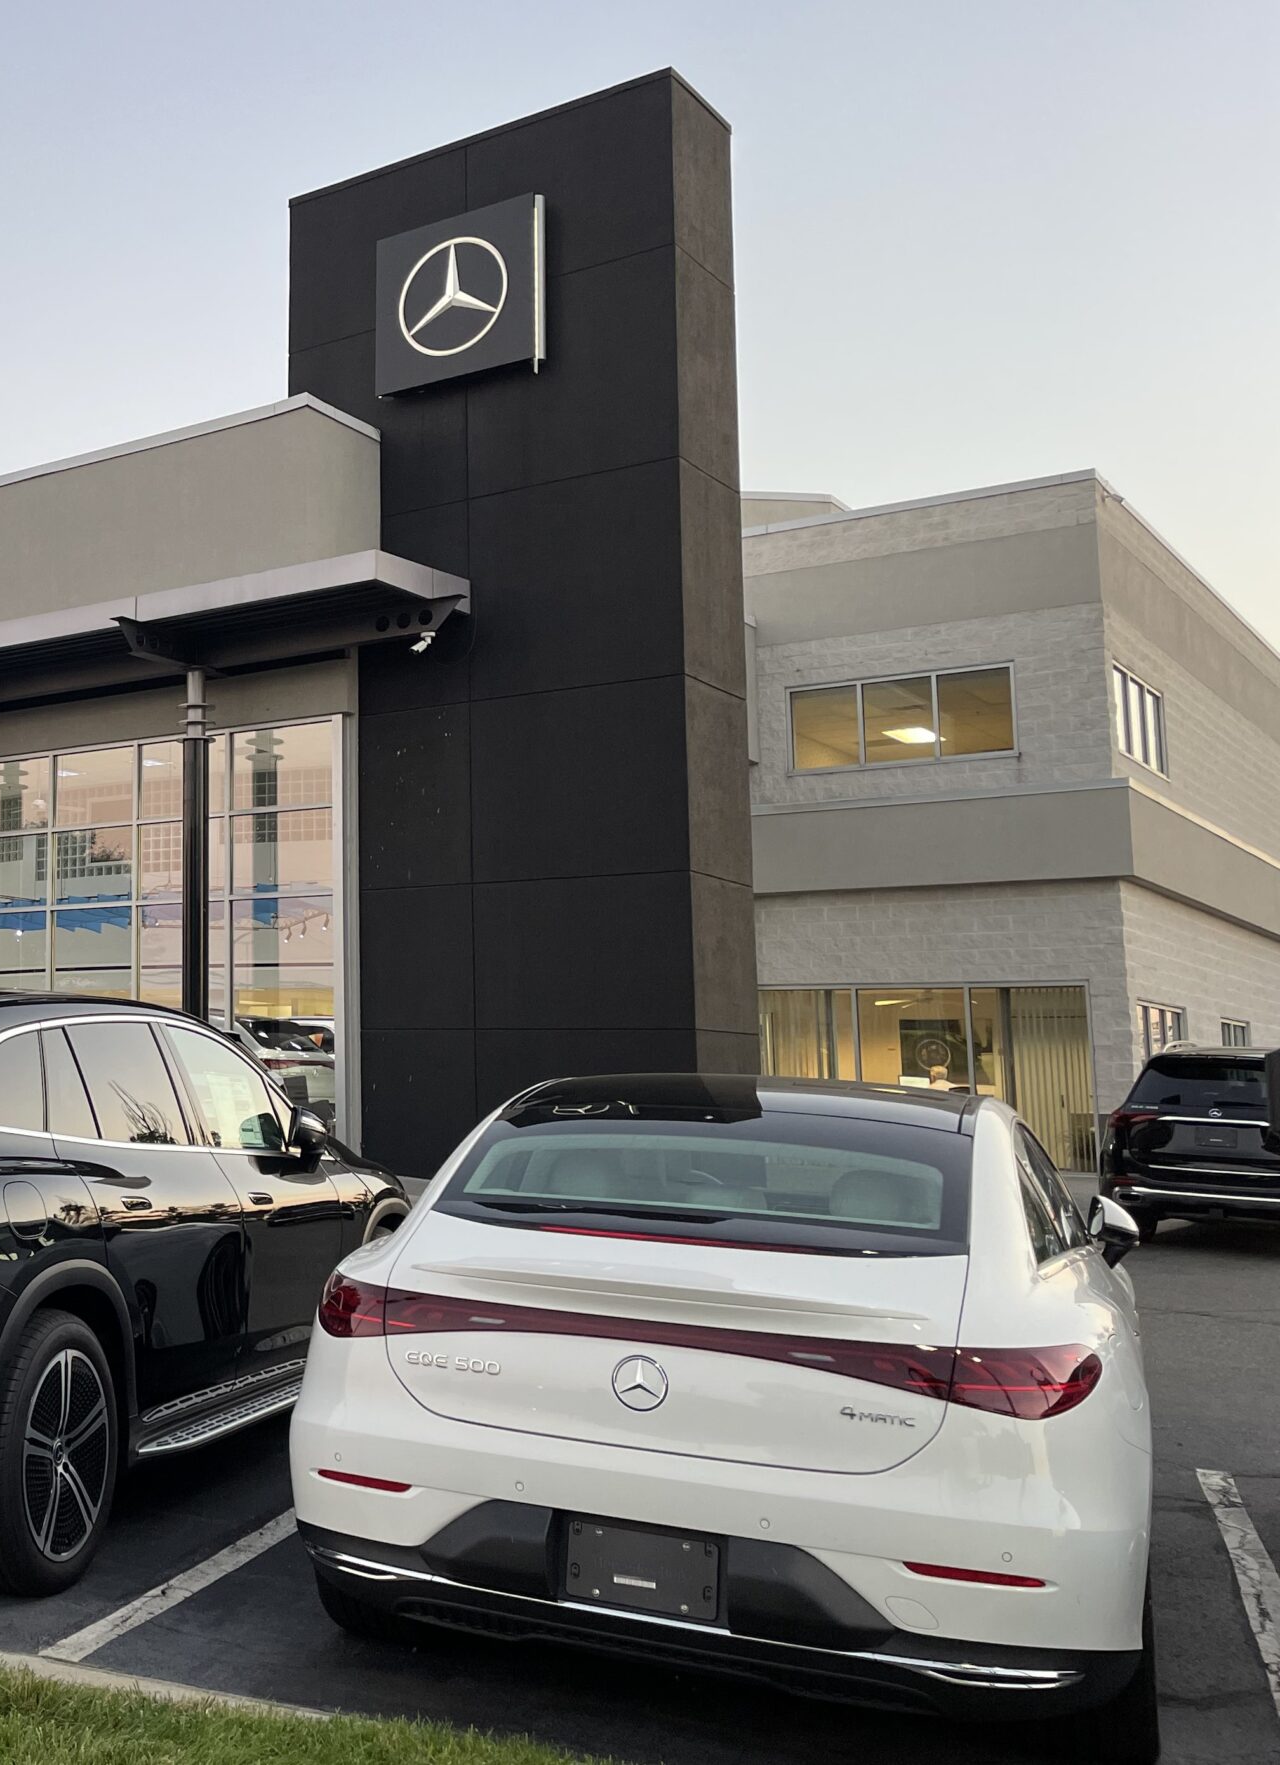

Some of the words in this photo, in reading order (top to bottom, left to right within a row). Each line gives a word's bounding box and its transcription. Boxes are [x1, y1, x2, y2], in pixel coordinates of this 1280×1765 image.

[405, 1350, 448, 1368] EQE
[455, 1356, 501, 1375] 500
[840, 1405, 916, 1427] 4MATIC
